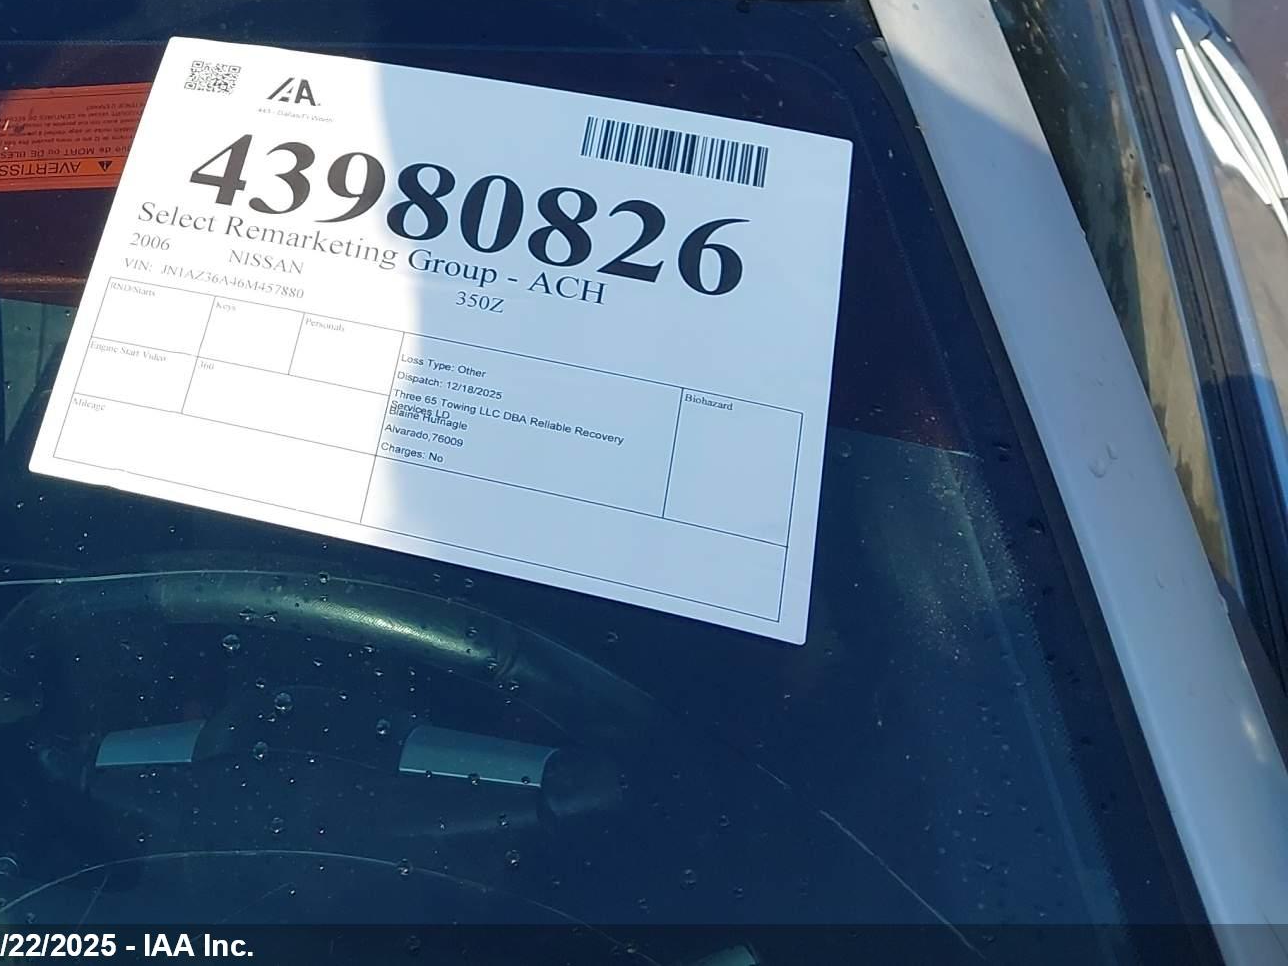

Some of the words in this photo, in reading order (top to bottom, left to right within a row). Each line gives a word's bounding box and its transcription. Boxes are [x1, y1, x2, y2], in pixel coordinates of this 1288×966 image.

[189, 134, 752, 296] 43980826
[123, 257, 153, 272] VIN:
[138, 201, 215, 233] Select
[224, 215, 399, 270] Remarketing
[408, 248, 498, 287] Group
[528, 271, 608, 305] ACH
[129, 232, 171, 251] 2006
[228, 249, 304, 275] NISSAN
[455, 291, 505, 314] 350Z
[304, 317, 345, 332] Personals
[401, 354, 424, 366] Loss
[427, 359, 455, 372] Type:
[458, 365, 486, 378] Other
[397, 371, 443, 388] Dispatch:
[446, 380, 503, 400] 12/18/2025
[391, 400, 433, 417] Services
[684, 393, 733, 411] Biohazard
[389, 406, 420, 420] Blaine
[422, 413, 469, 431] Hufnagle
[393, 388, 422, 403] Three
[424, 395, 438, 406] 65
[441, 398, 477, 416] Towing
[479, 406, 501, 419] LLC
[503, 410, 528, 424] DBA
[530, 417, 572, 434] Reliable
[574, 426, 625, 446] Recovery
[384, 424, 464, 448] Alvarado,76009
[380, 441, 426, 461] Charges:
[428, 452, 444, 464] No
